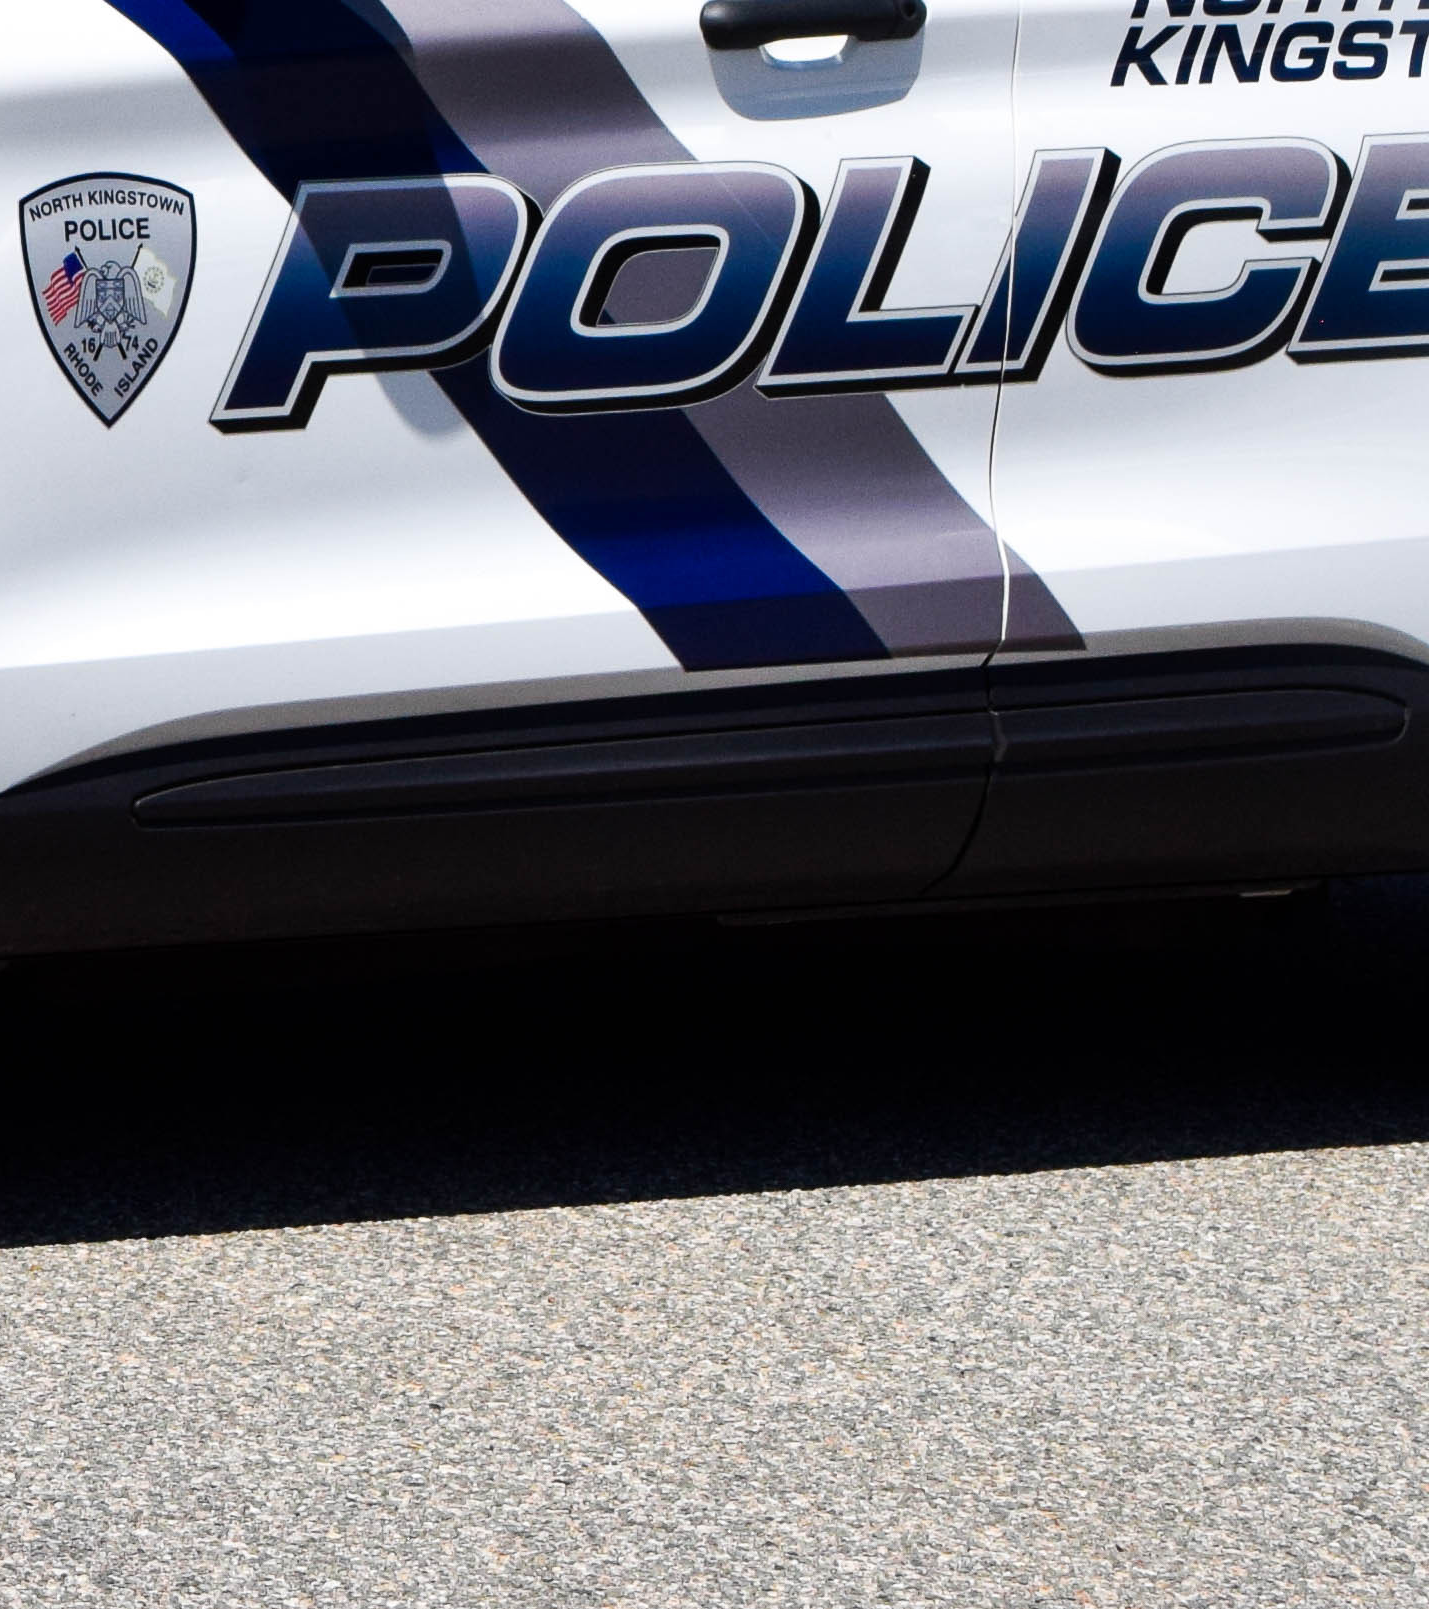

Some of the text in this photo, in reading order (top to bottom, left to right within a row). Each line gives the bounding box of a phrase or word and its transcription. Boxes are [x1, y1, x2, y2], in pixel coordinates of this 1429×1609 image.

[29, 189, 185, 222] NORTH KINGSTOWN
[64, 217, 151, 242] POLICE
[81, 337, 96, 354] 16
[64, 342, 104, 397] RHODE
[114, 338, 158, 398] ISLAND
